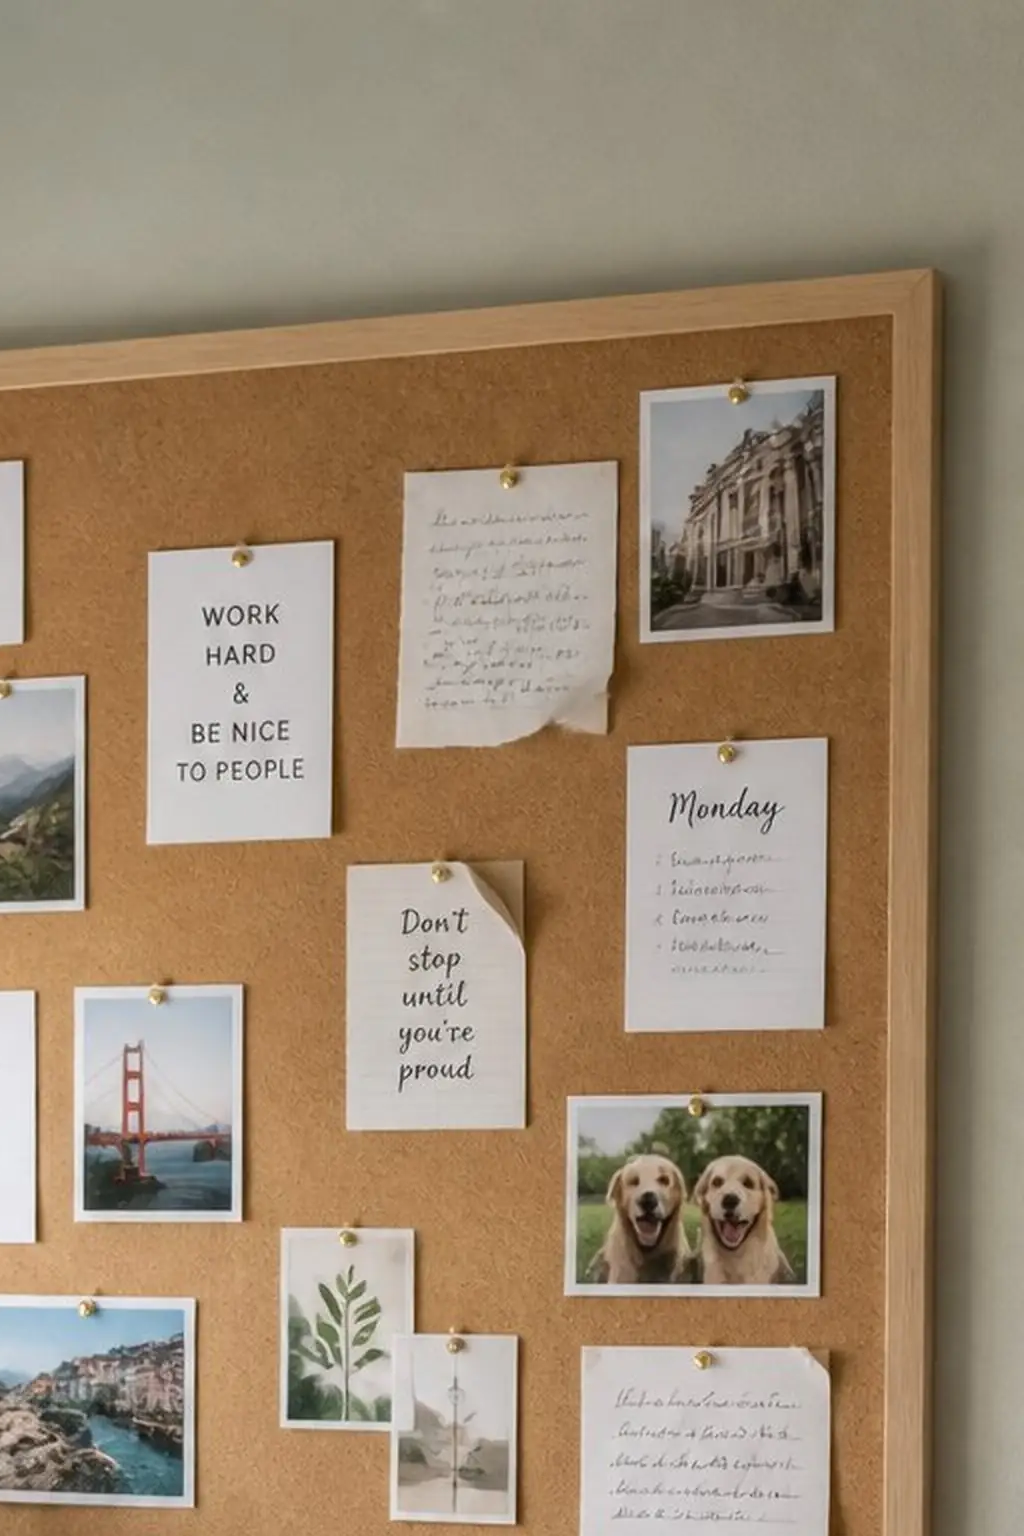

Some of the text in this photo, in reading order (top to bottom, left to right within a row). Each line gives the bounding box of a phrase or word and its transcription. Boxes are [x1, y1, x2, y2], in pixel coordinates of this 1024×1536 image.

[201, 603, 280, 627] WORK
[206, 640, 275, 666] HARD
[233, 682, 249, 704] &
[192, 720, 290, 745] BE NICE
[176, 756, 304, 782] TO PEOPLE
[669, 786, 785, 835] Monday
[401, 908, 470, 934] Don't
[408, 945, 461, 978] stop
[402, 980, 469, 1008] until
[399, 1020, 475, 1055] you're
[398, 1054, 475, 1093] proud
